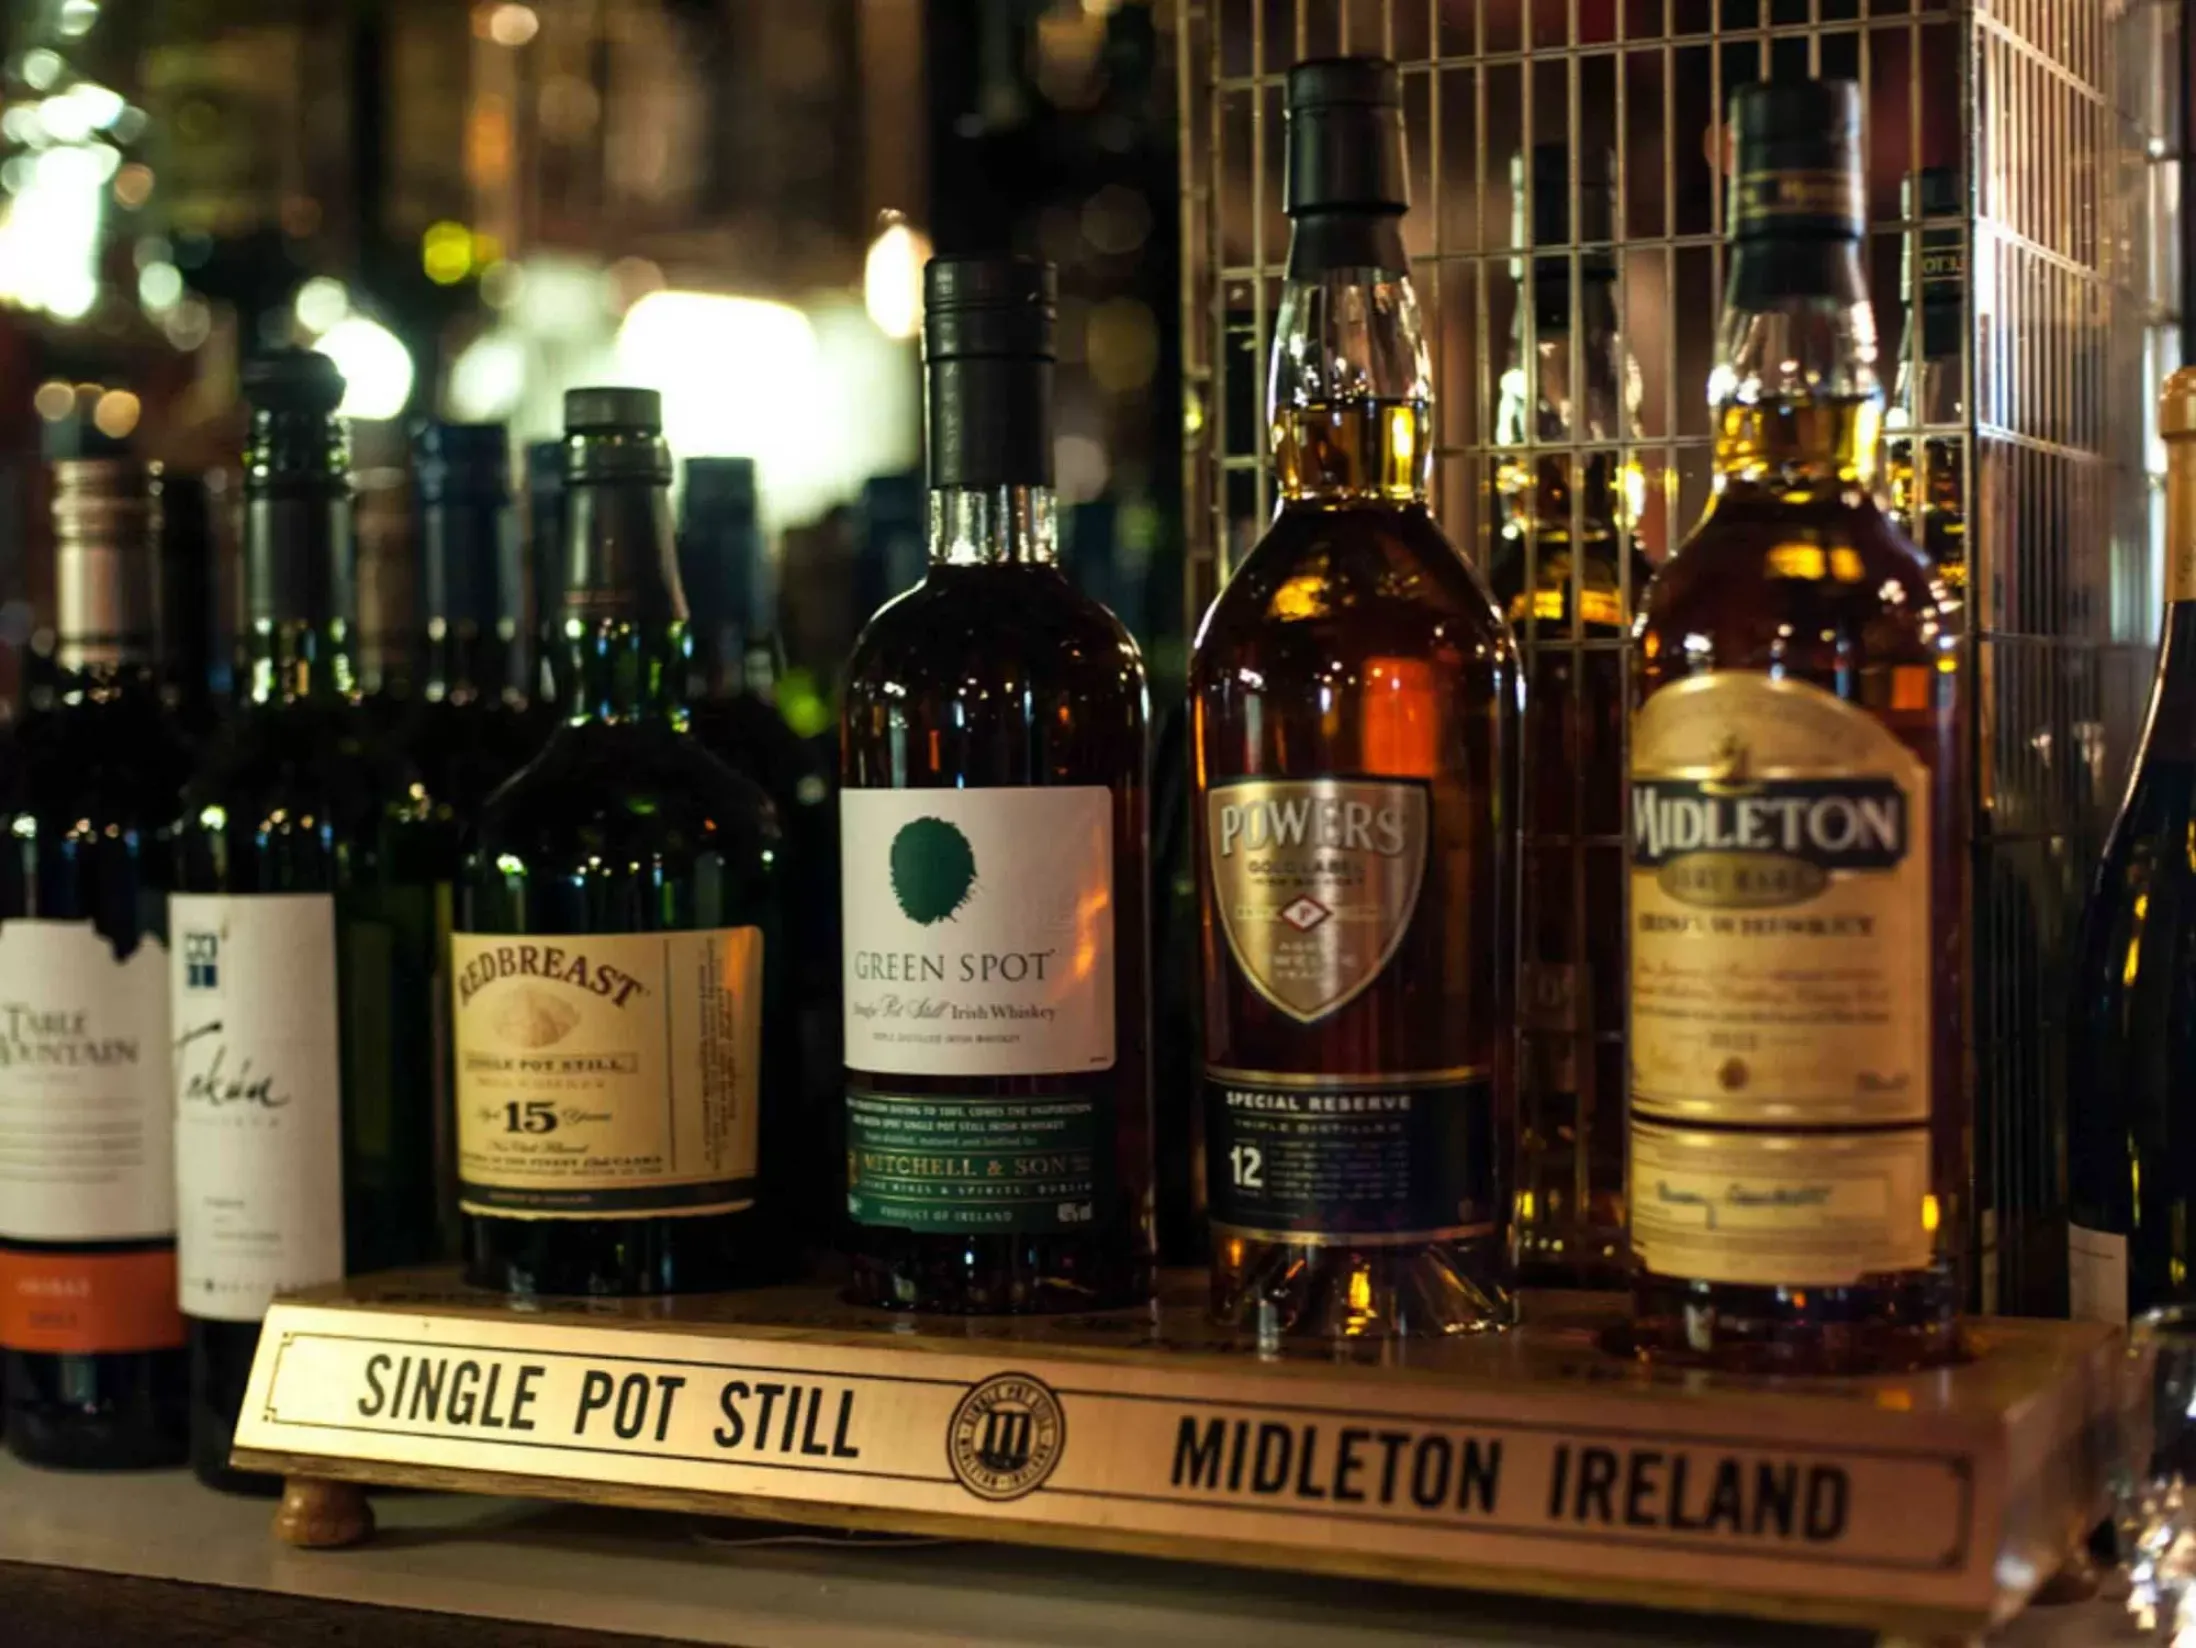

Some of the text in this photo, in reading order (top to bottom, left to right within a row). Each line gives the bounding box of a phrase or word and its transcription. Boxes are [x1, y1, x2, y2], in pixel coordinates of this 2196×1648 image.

[1220, 797, 1405, 858] POWERS
[1632, 786, 1900, 858] MIDLETON
[458, 945, 642, 1007] REDBREAST
[854, 950, 1052, 982] GREEN SPOT
[952, 1004, 988, 1020] Irish
[989, 1003, 1056, 1023] Whiskey
[504, 1100, 559, 1135] 15
[1226, 1091, 1412, 1111] SPECIAL RESERVE
[863, 1153, 977, 1177] MITCHELL
[987, 1159, 1005, 1176] &
[1014, 1156, 1067, 1176] SON
[1229, 1145, 1264, 1188] 12
[358, 1353, 859, 1459] SINGLE POT STILL
[1170, 1416, 1850, 1544] MIDLETON IRELAND
